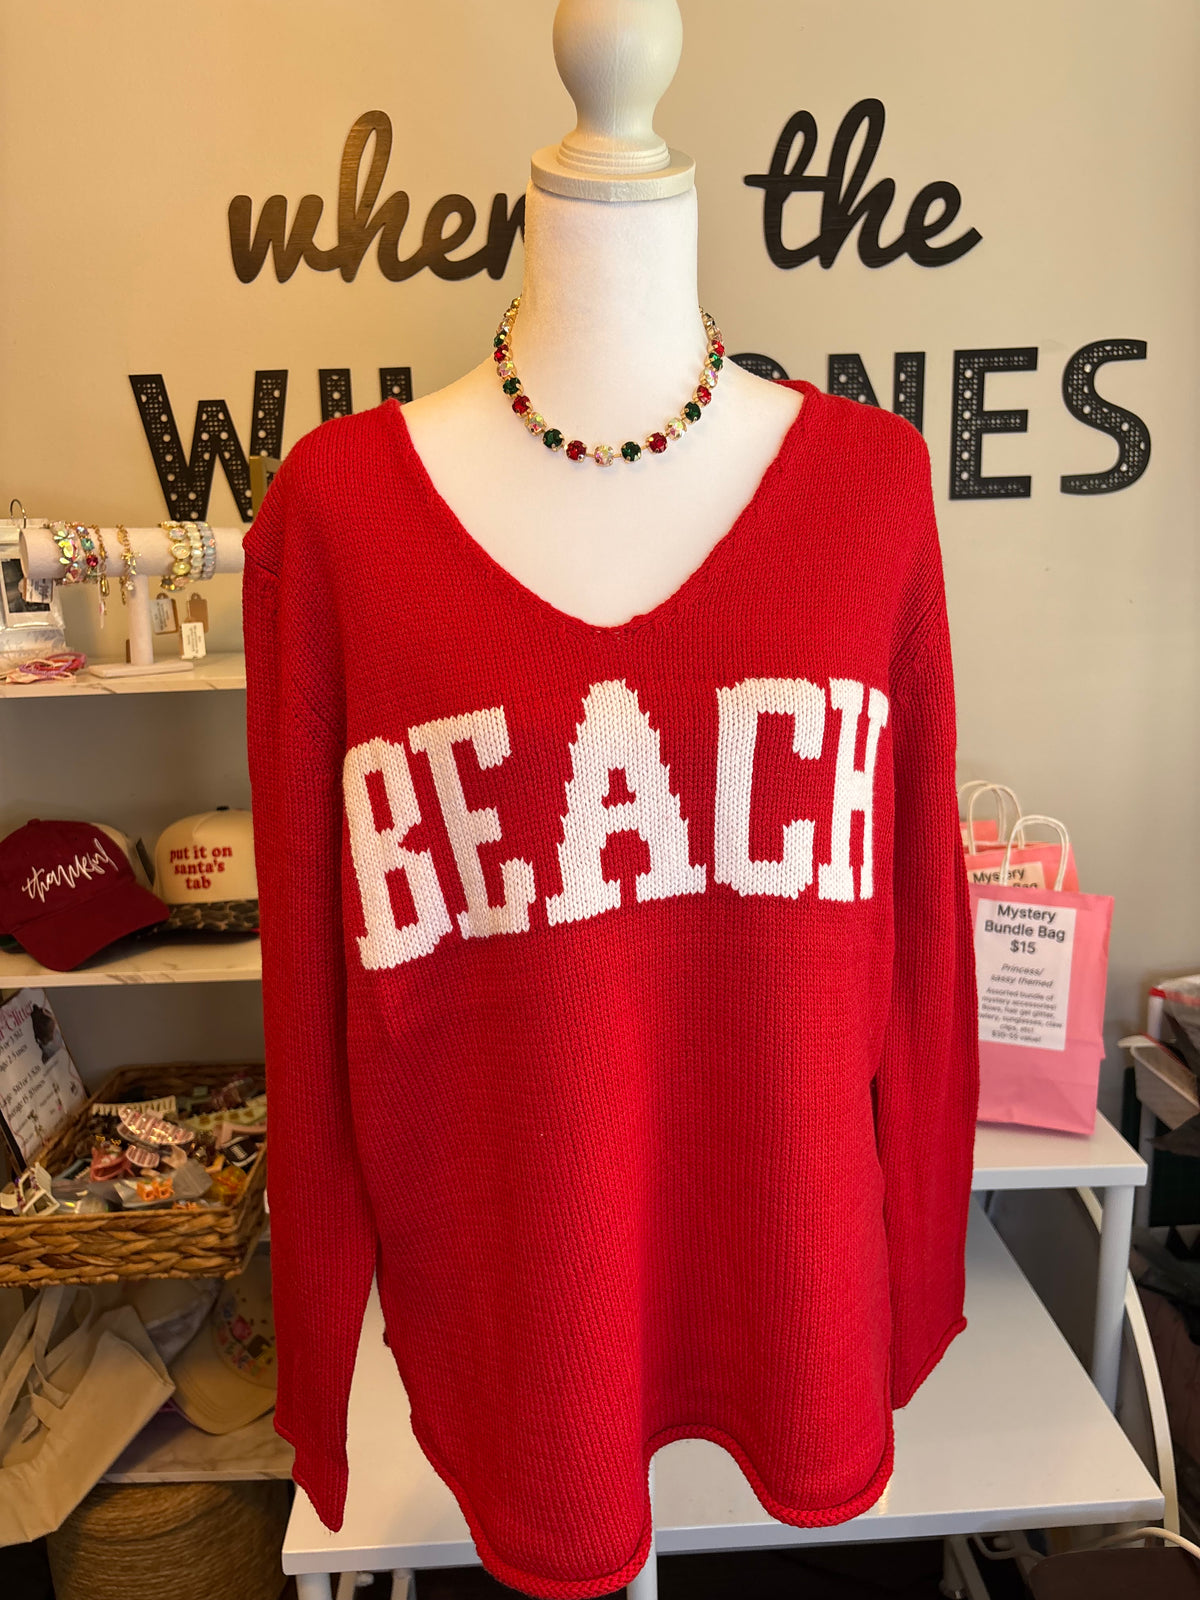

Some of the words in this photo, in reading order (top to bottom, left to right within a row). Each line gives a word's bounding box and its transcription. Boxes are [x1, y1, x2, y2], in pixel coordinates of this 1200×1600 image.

[228, 110, 526, 284] wher
[743, 97, 983, 270] the
[728, 338, 1151, 501] ES
[343, 678, 889, 970] BEACH
[169, 846, 190, 864] put
[193, 844, 207, 859] it
[211, 846, 233, 858] on
[174, 858, 226, 875] santa's
[972, 868, 1025, 885] Mysry
[185, 875, 212, 890] tab
[997, 904, 1056, 924] Mystery
[984, 919, 1034, 937] Bundle
[1037, 925, 1066, 944] Bag
[1009, 939, 1037, 955] $15
